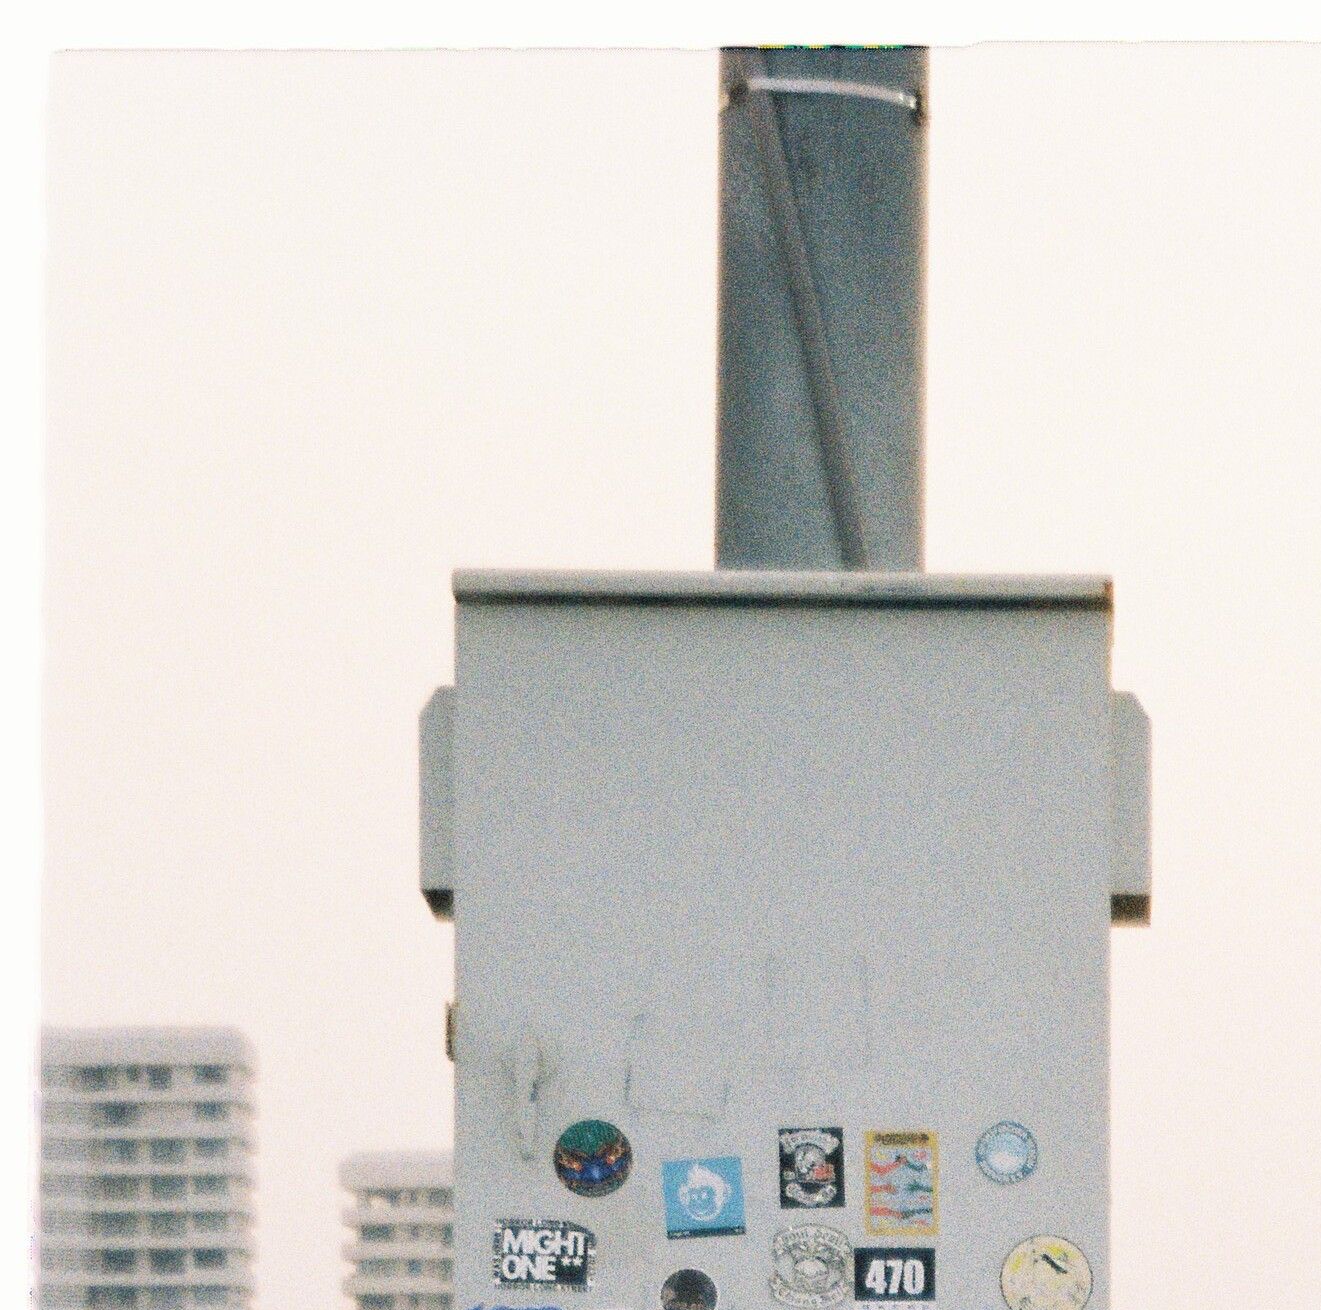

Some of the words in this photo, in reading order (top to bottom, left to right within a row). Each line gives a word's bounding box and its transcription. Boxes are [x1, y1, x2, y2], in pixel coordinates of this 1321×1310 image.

[502, 1229, 588, 1256] MIGHT
[501, 1255, 557, 1281] ONE
[865, 1258, 926, 1295] 470
